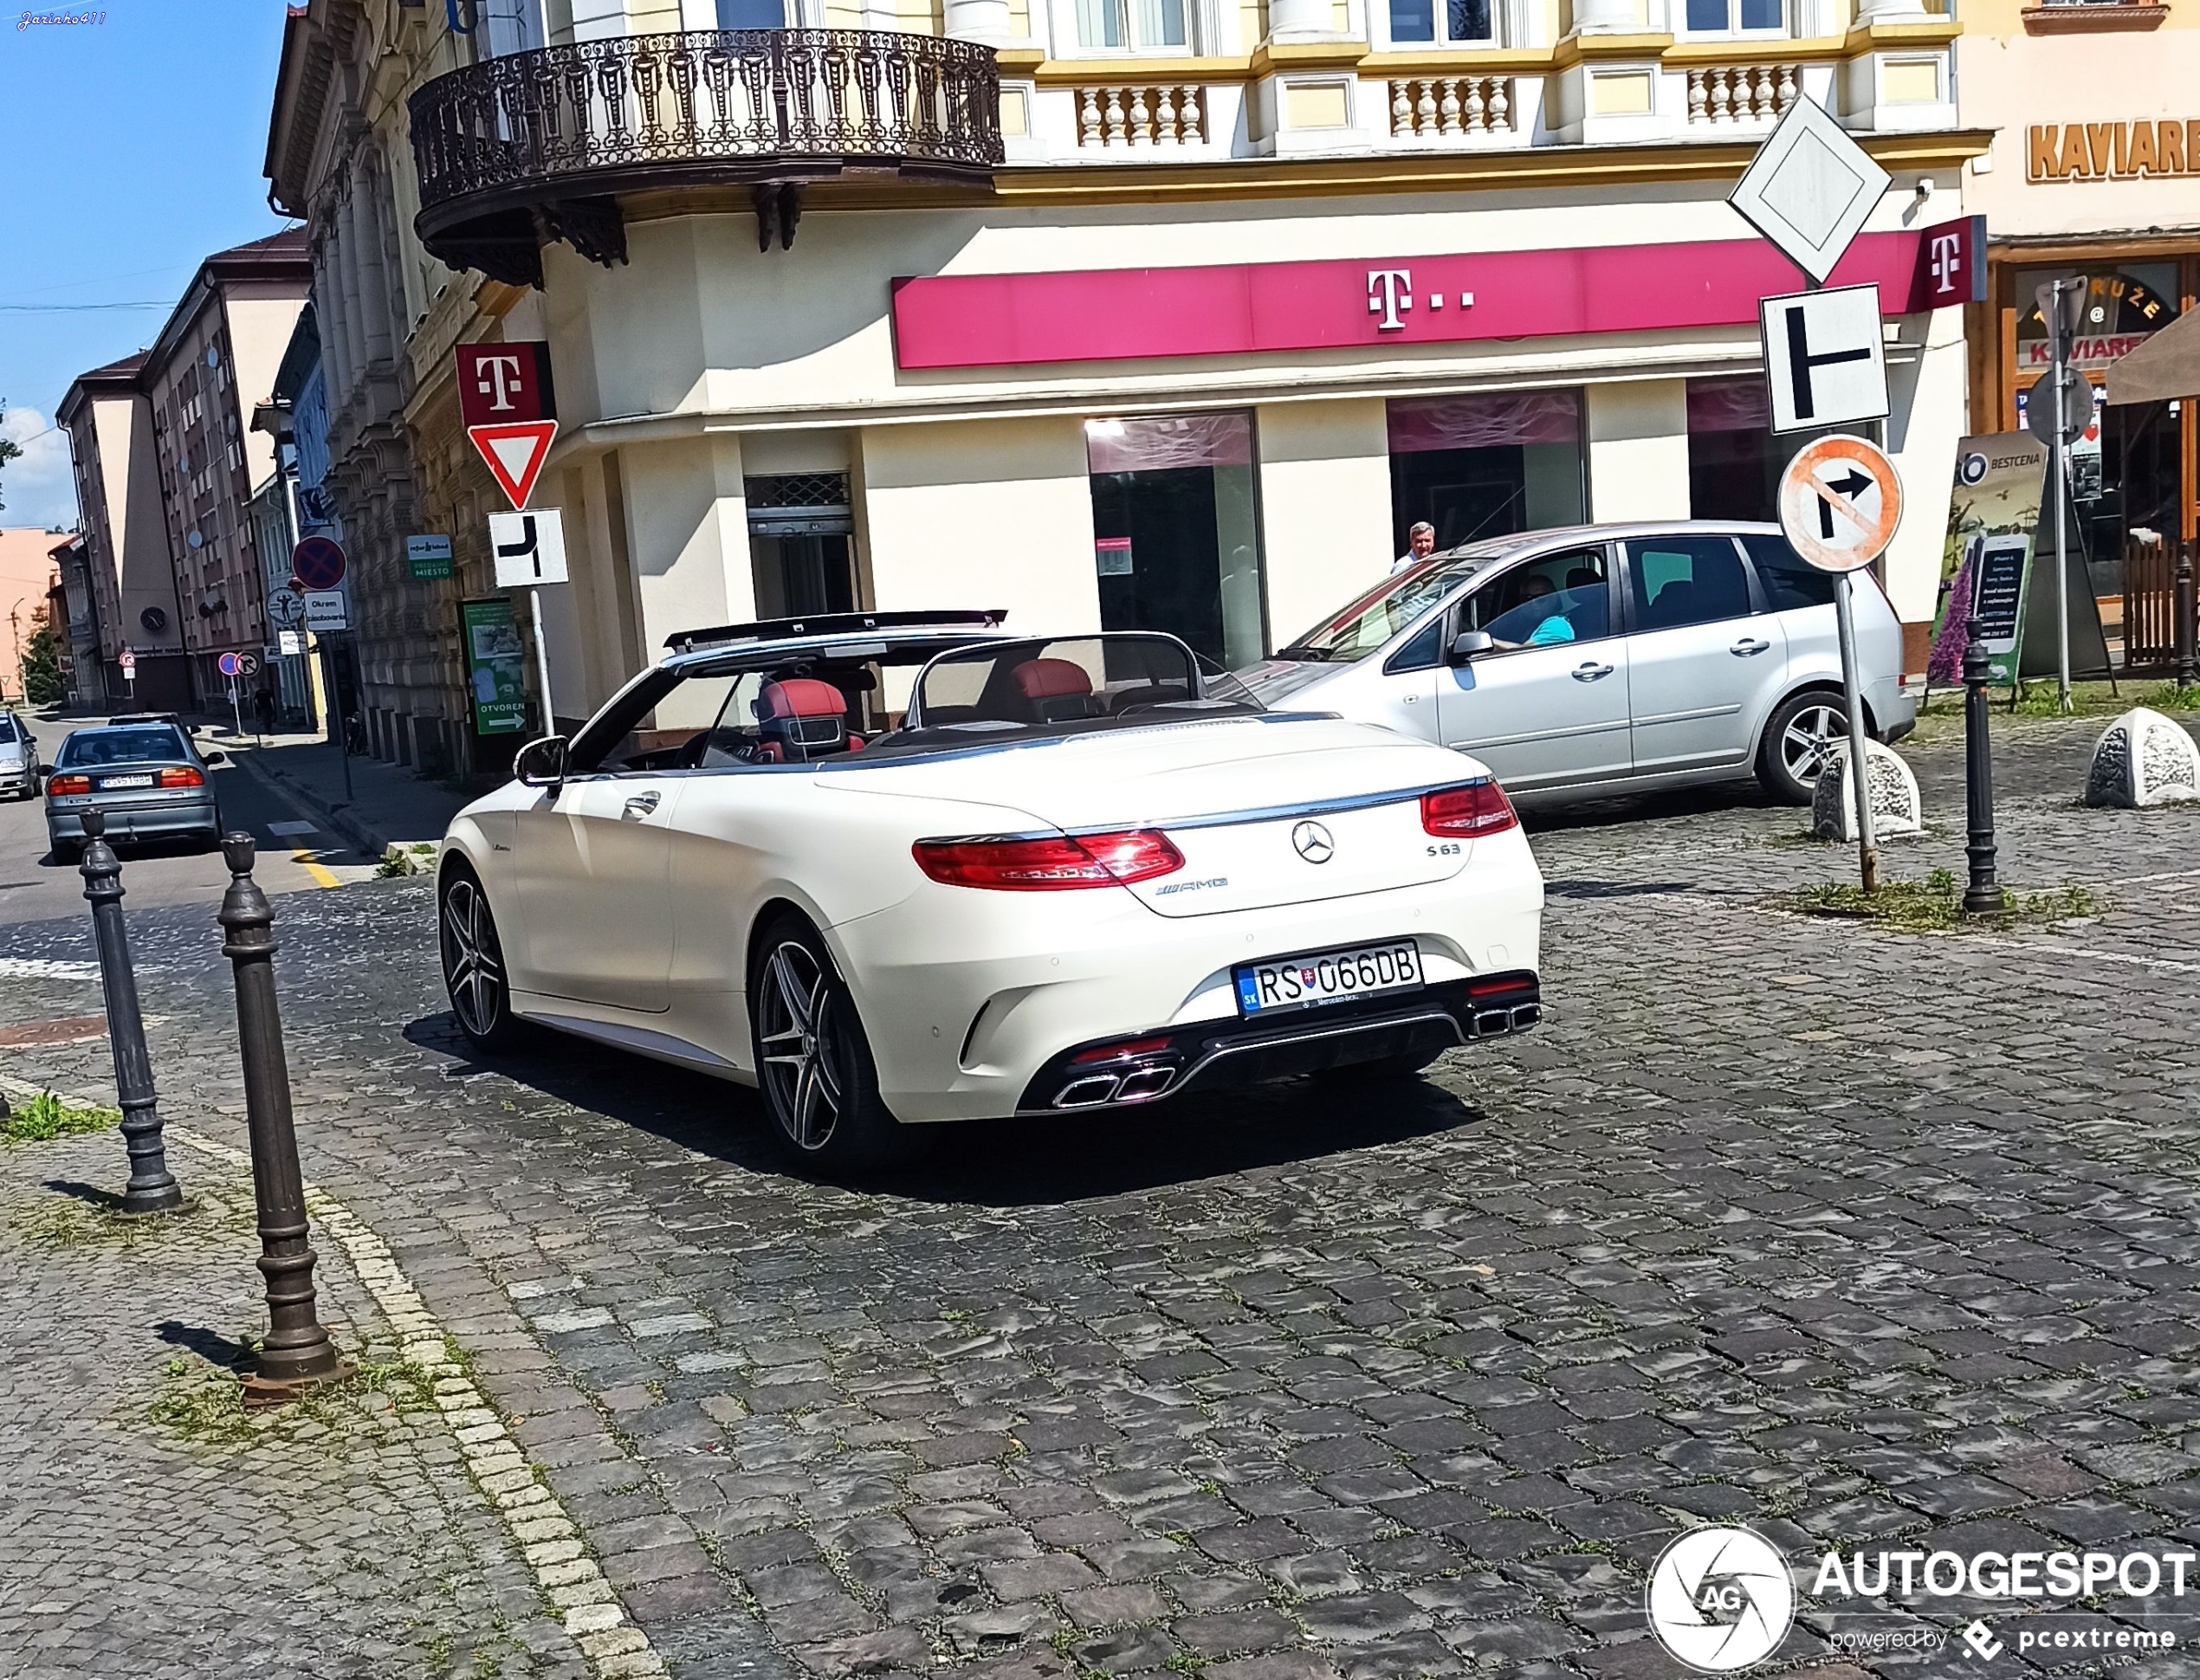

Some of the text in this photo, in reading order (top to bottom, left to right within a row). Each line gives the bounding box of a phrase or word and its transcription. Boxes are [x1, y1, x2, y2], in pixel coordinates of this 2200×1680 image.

[476, 356, 522, 410] T
[1991, 453, 2040, 469] BESTCENA
[416, 567, 449, 576] MIESTO
[1427, 843, 1461, 856] S 63
[1259, 948, 1414, 1003] RS 066DB
[1245, 993, 1257, 1005] SK
